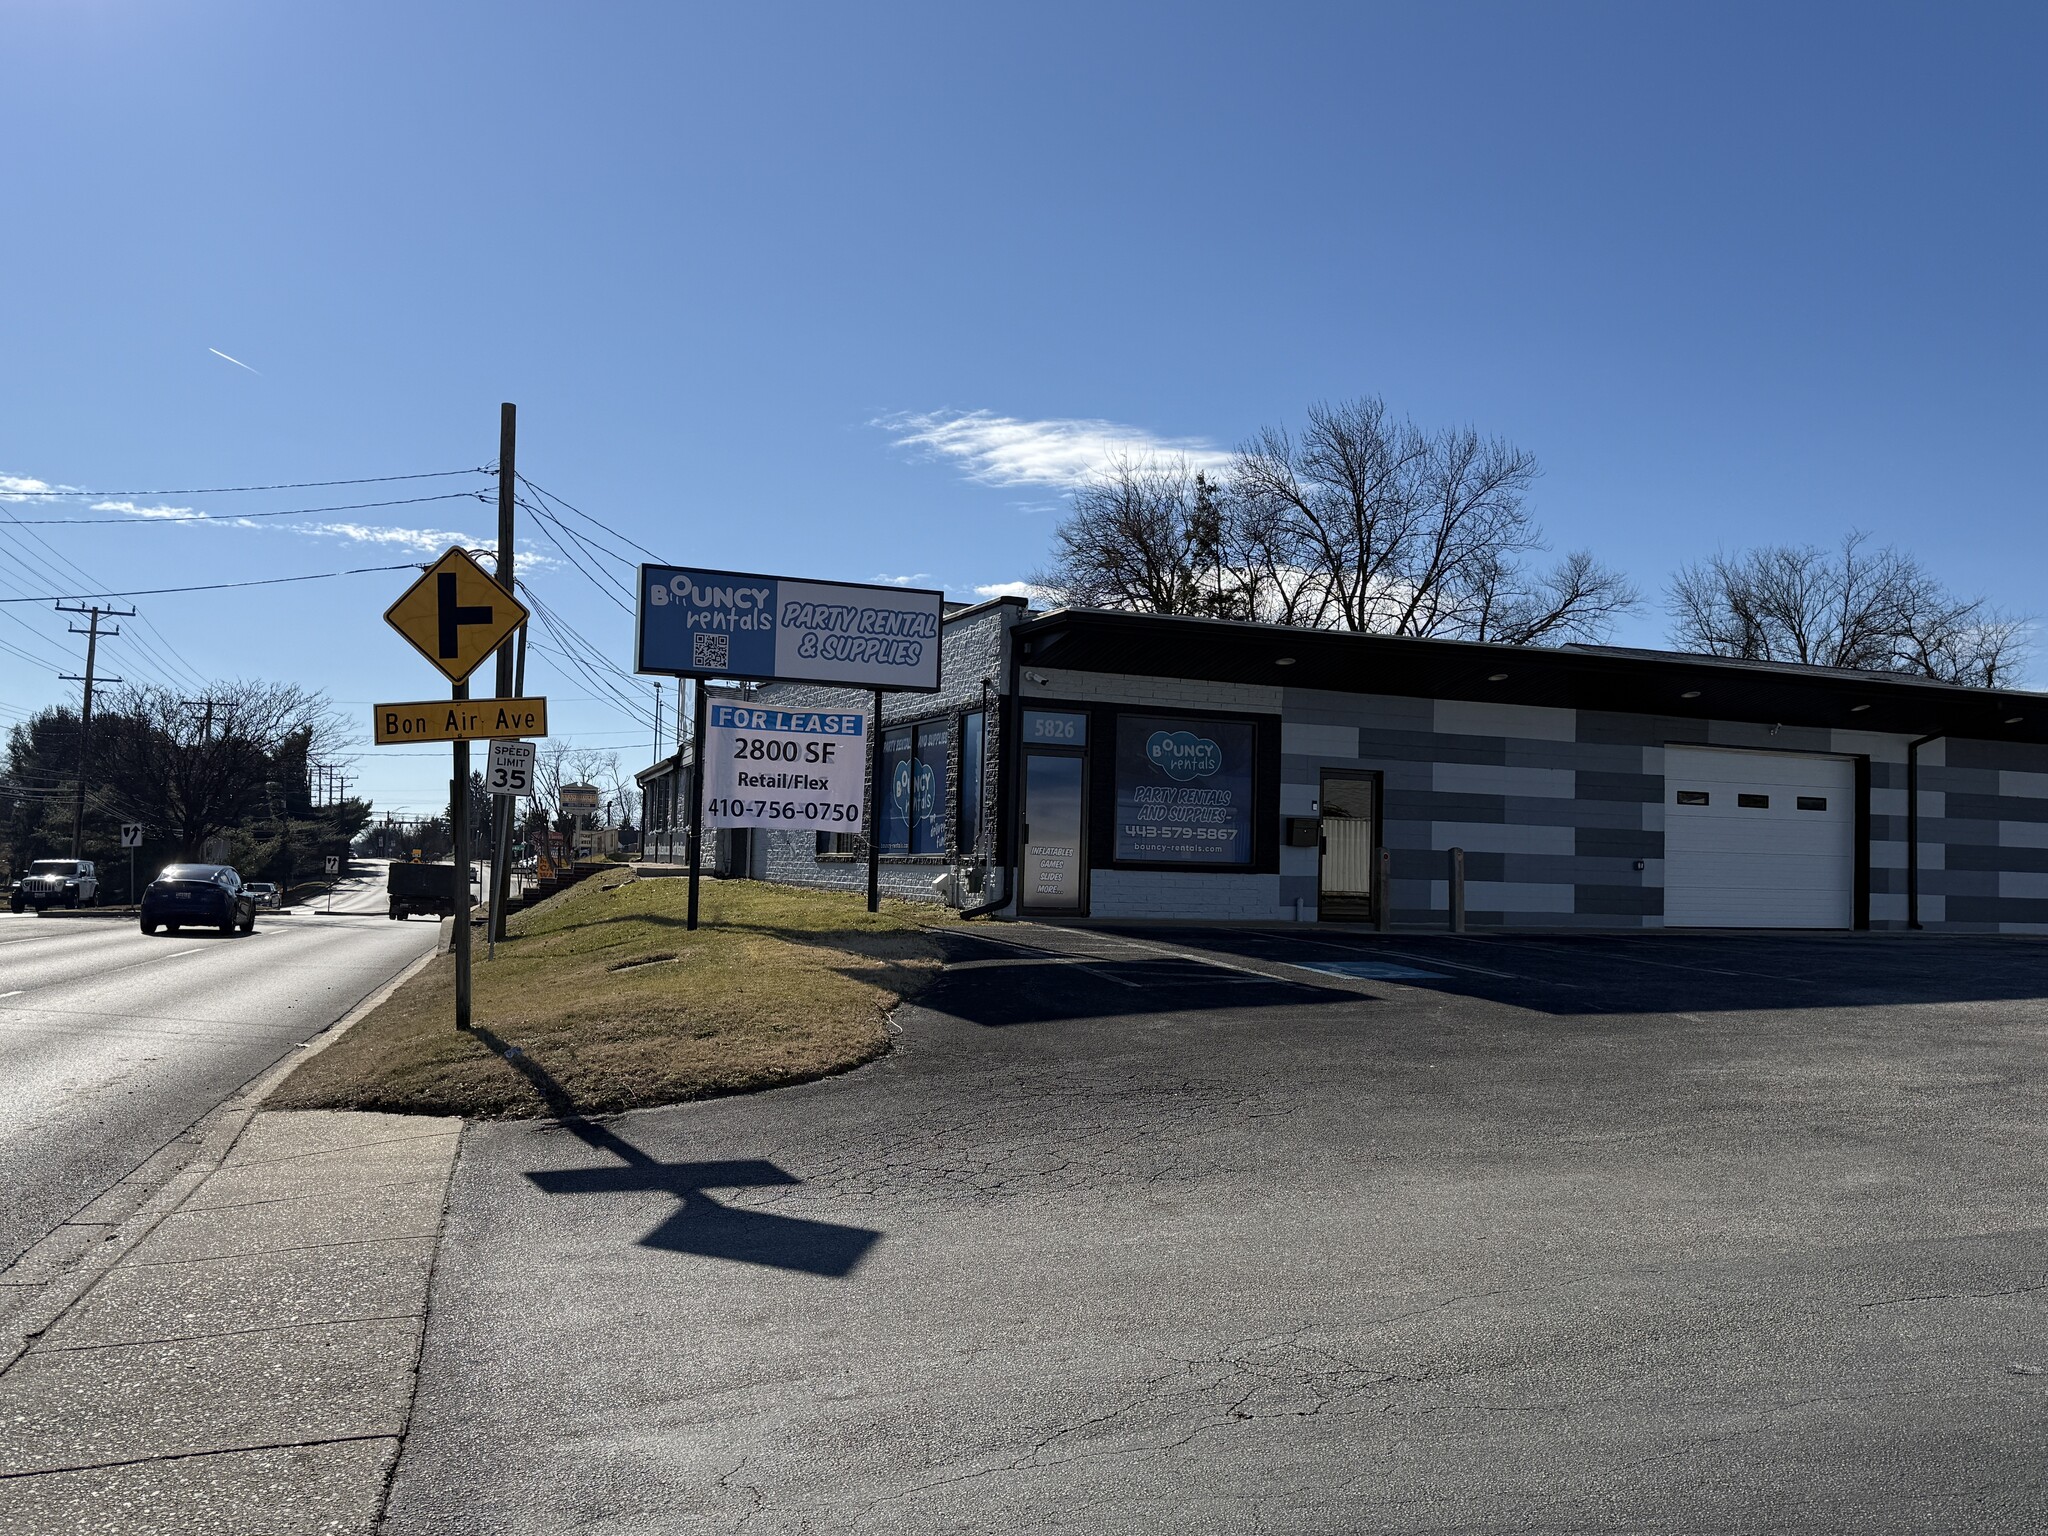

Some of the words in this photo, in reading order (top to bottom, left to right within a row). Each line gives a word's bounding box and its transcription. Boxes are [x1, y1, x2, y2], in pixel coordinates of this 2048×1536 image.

[651, 575, 770, 609] BOUNCY
[686, 607, 773, 632] rentals
[781, 601, 858, 632] PARTY
[857, 608, 937, 638] RENTAL
[798, 632, 819, 658] &
[820, 634, 922, 666] SUPPLIES
[385, 713, 426, 735] Bon
[445, 709, 478, 732] Air
[495, 708, 535, 730] Ave
[719, 707, 767, 729] FOR
[775, 713, 856, 734] LEASE
[1034, 719, 1075, 738] 5826
[494, 746, 530, 757] SPEED
[734, 738, 798, 762] 2800
[805, 742, 836, 763] SF
[1152, 739, 1214, 757] BOUNCY
[496, 757, 525, 768] LIMIT
[1170, 756, 1216, 771] rentals
[492, 768, 526, 790] 35
[738, 772, 829, 791] Retail/Flex
[1134, 786, 1177, 803] PARTY
[1178, 788, 1232, 806] RENTALS
[708, 798, 859, 822] 410-756-0750
[1137, 804, 1168, 821] AND
[1125, 826, 1238, 840] 443-579-5867
[1031, 846, 1074, 857] INFLATABLES
[1134, 843, 1222, 853] bouncy-rentals.com
[1040, 859, 1064, 869] GAMES
[1040, 872, 1063, 882] SLIDES
